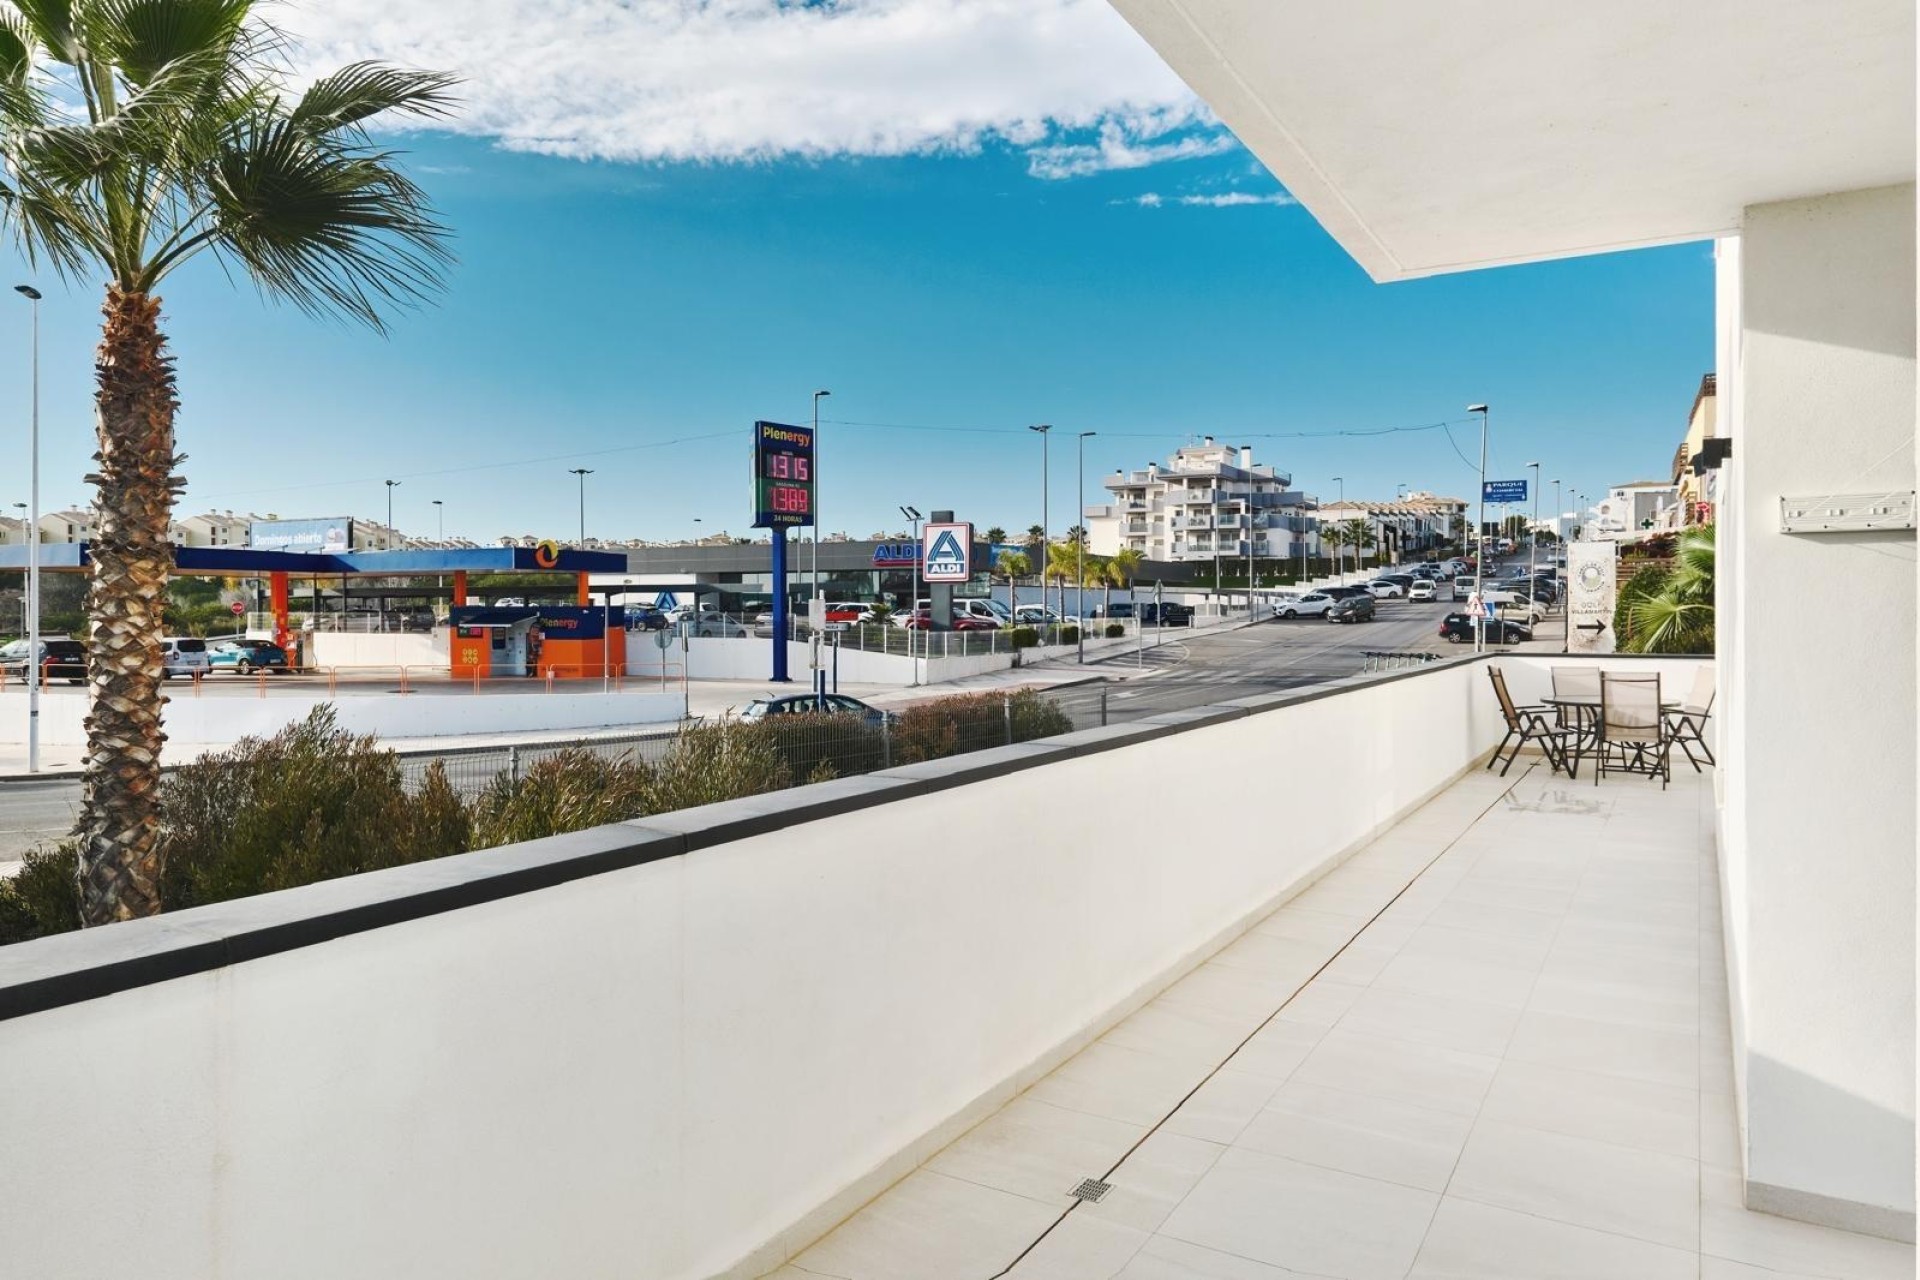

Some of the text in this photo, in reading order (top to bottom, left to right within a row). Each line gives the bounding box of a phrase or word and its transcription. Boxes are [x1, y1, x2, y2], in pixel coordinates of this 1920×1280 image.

[763, 426, 810, 447] Plenergy
[254, 532, 322, 546] Domingos abierto
[873, 544, 923, 561] ALDI
[931, 564, 960, 573] ALDI
